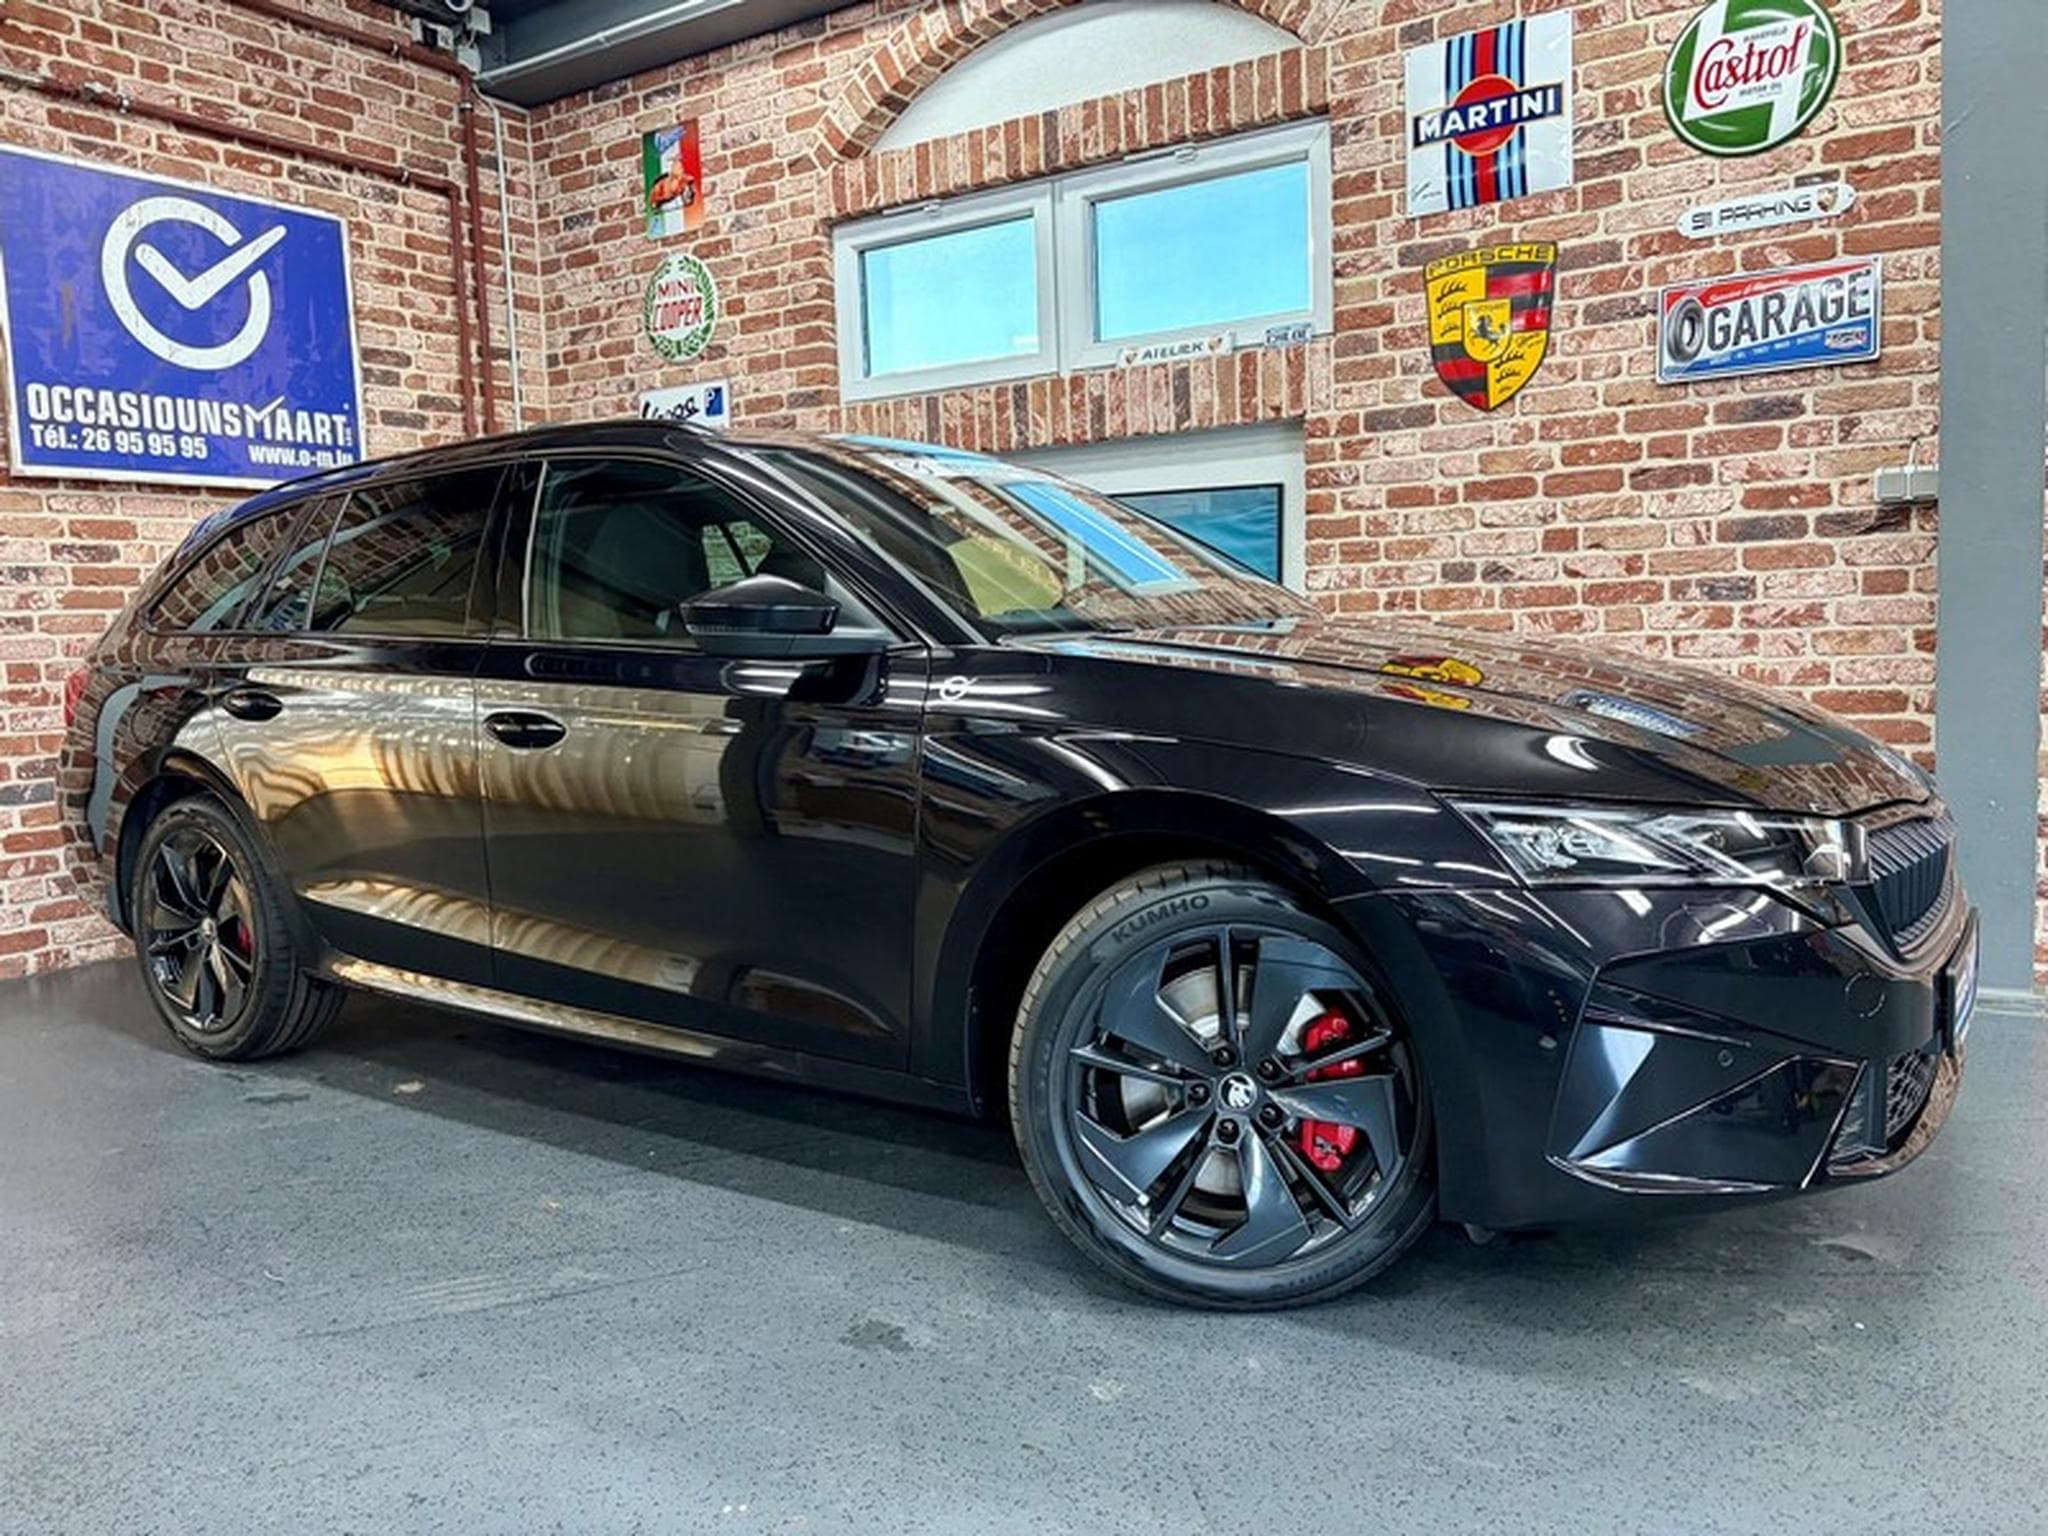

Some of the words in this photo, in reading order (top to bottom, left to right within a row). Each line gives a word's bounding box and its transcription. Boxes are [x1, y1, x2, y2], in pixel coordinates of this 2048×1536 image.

[1694, 22, 1809, 110] Castrol
[1417, 87, 1556, 142] MARTINI
[1719, 194, 1811, 225] PARKING
[1428, 247, 1550, 277] PORSCHE
[657, 278, 694, 299] MINI
[653, 297, 702, 332] COOPER
[1706, 269, 1872, 351] GARAGE
[30, 424, 78, 449] Tél.:
[82, 427, 111, 452] 26
[114, 431, 143, 455] 95
[147, 434, 175, 457] 95
[179, 437, 208, 459] 95
[1111, 894, 1210, 944] KUMHO
